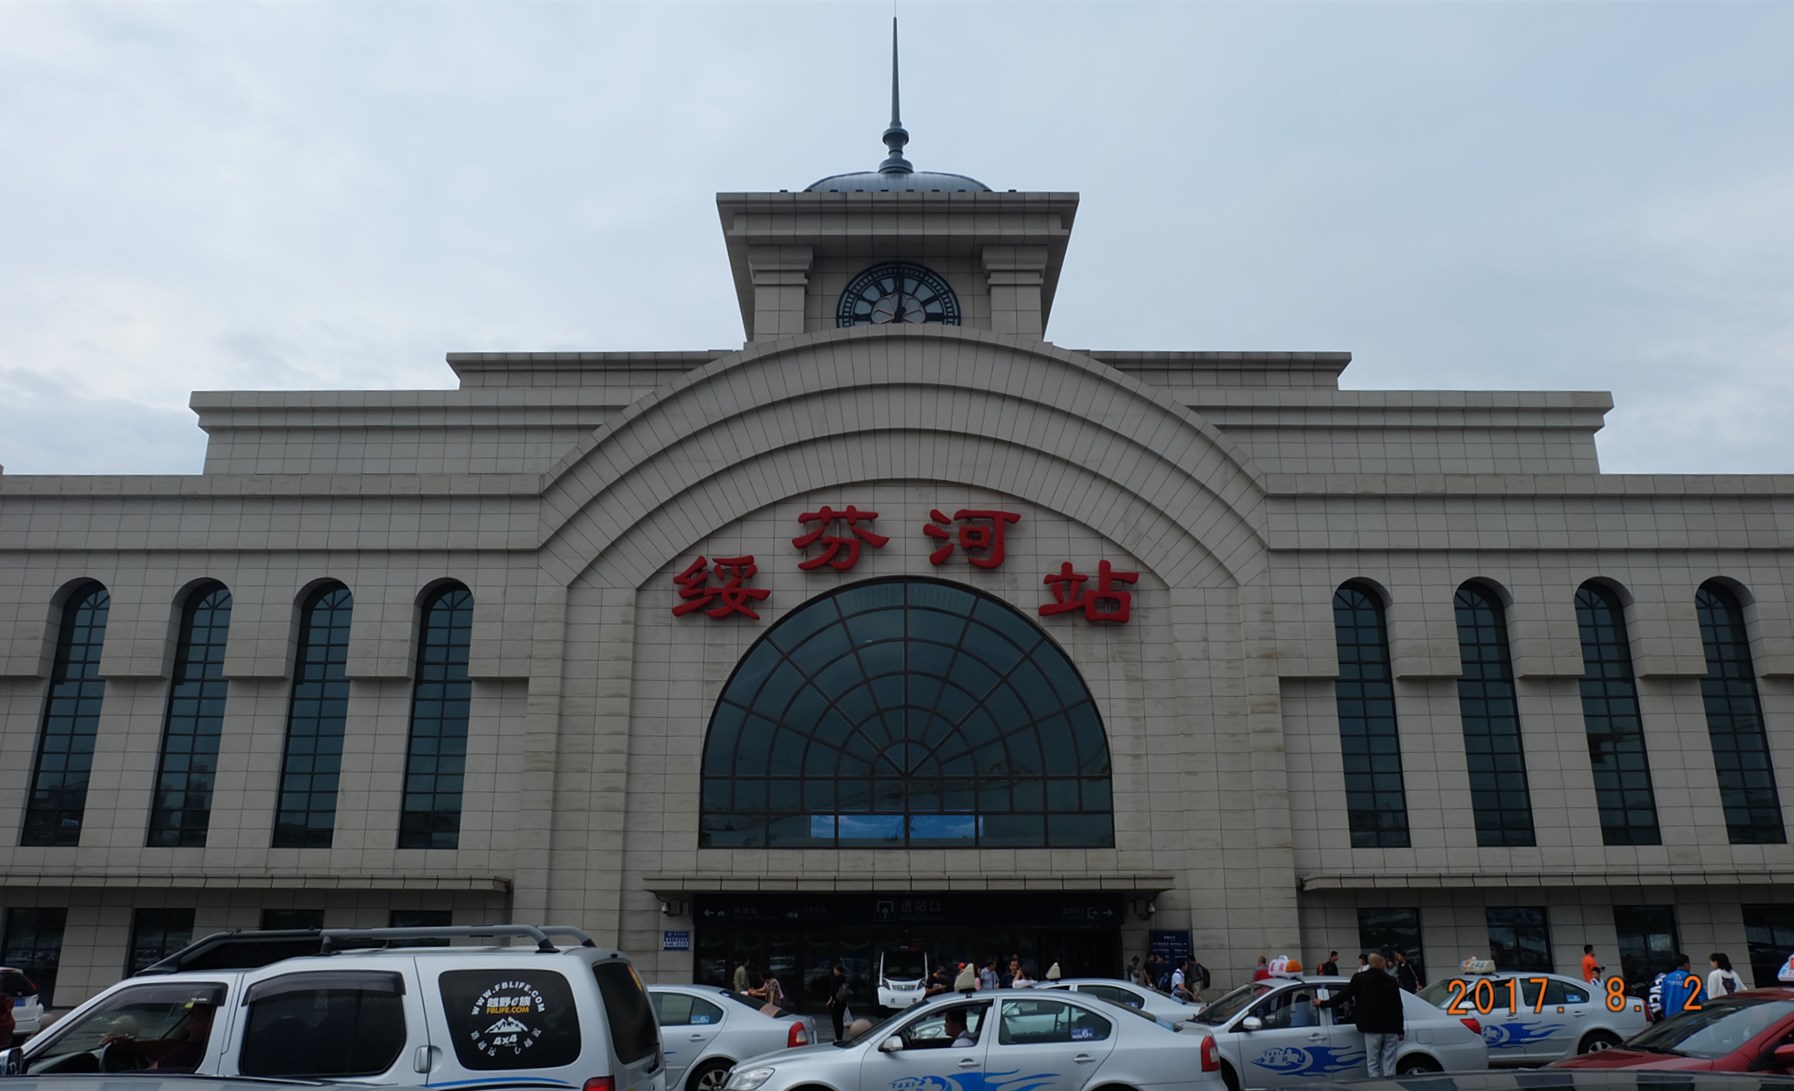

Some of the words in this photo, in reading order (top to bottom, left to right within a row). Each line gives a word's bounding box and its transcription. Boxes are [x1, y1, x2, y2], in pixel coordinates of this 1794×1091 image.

[671, 504, 1139, 625] 绥芬河站
[471, 981, 546, 1016] WWW.FBLIFE.COM
[892, 1081, 916, 1089] TAXI
